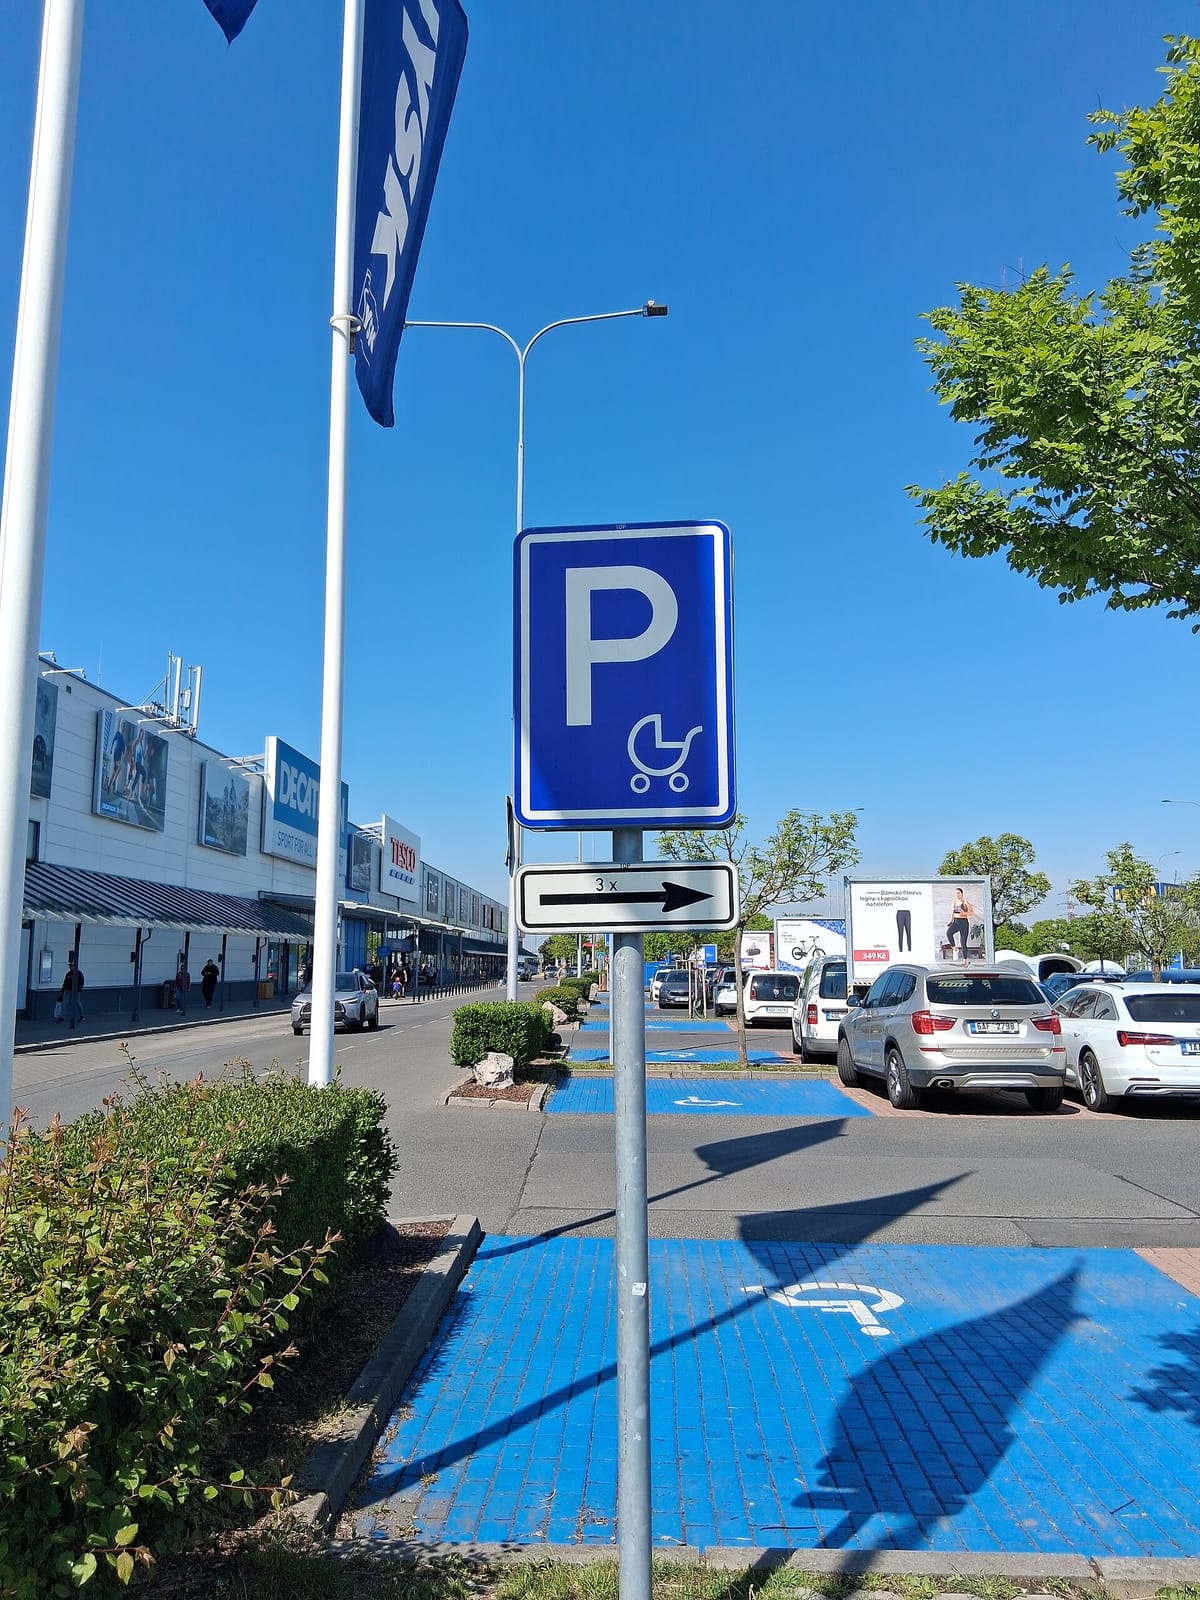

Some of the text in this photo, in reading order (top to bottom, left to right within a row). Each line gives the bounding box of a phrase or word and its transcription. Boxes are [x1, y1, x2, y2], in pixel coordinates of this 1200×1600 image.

[566, 565, 679, 727] P
[279, 759, 345, 833] DECATN
[277, 830, 313, 858] SPORT FOR ALL
[390, 836, 416, 873] TESCO
[595, 877, 604, 892] 3
[862, 952, 886, 960] 349 Kč
[996, 1022, 1015, 1030] 2798
[1189, 1042, 1200, 1051] 1A
